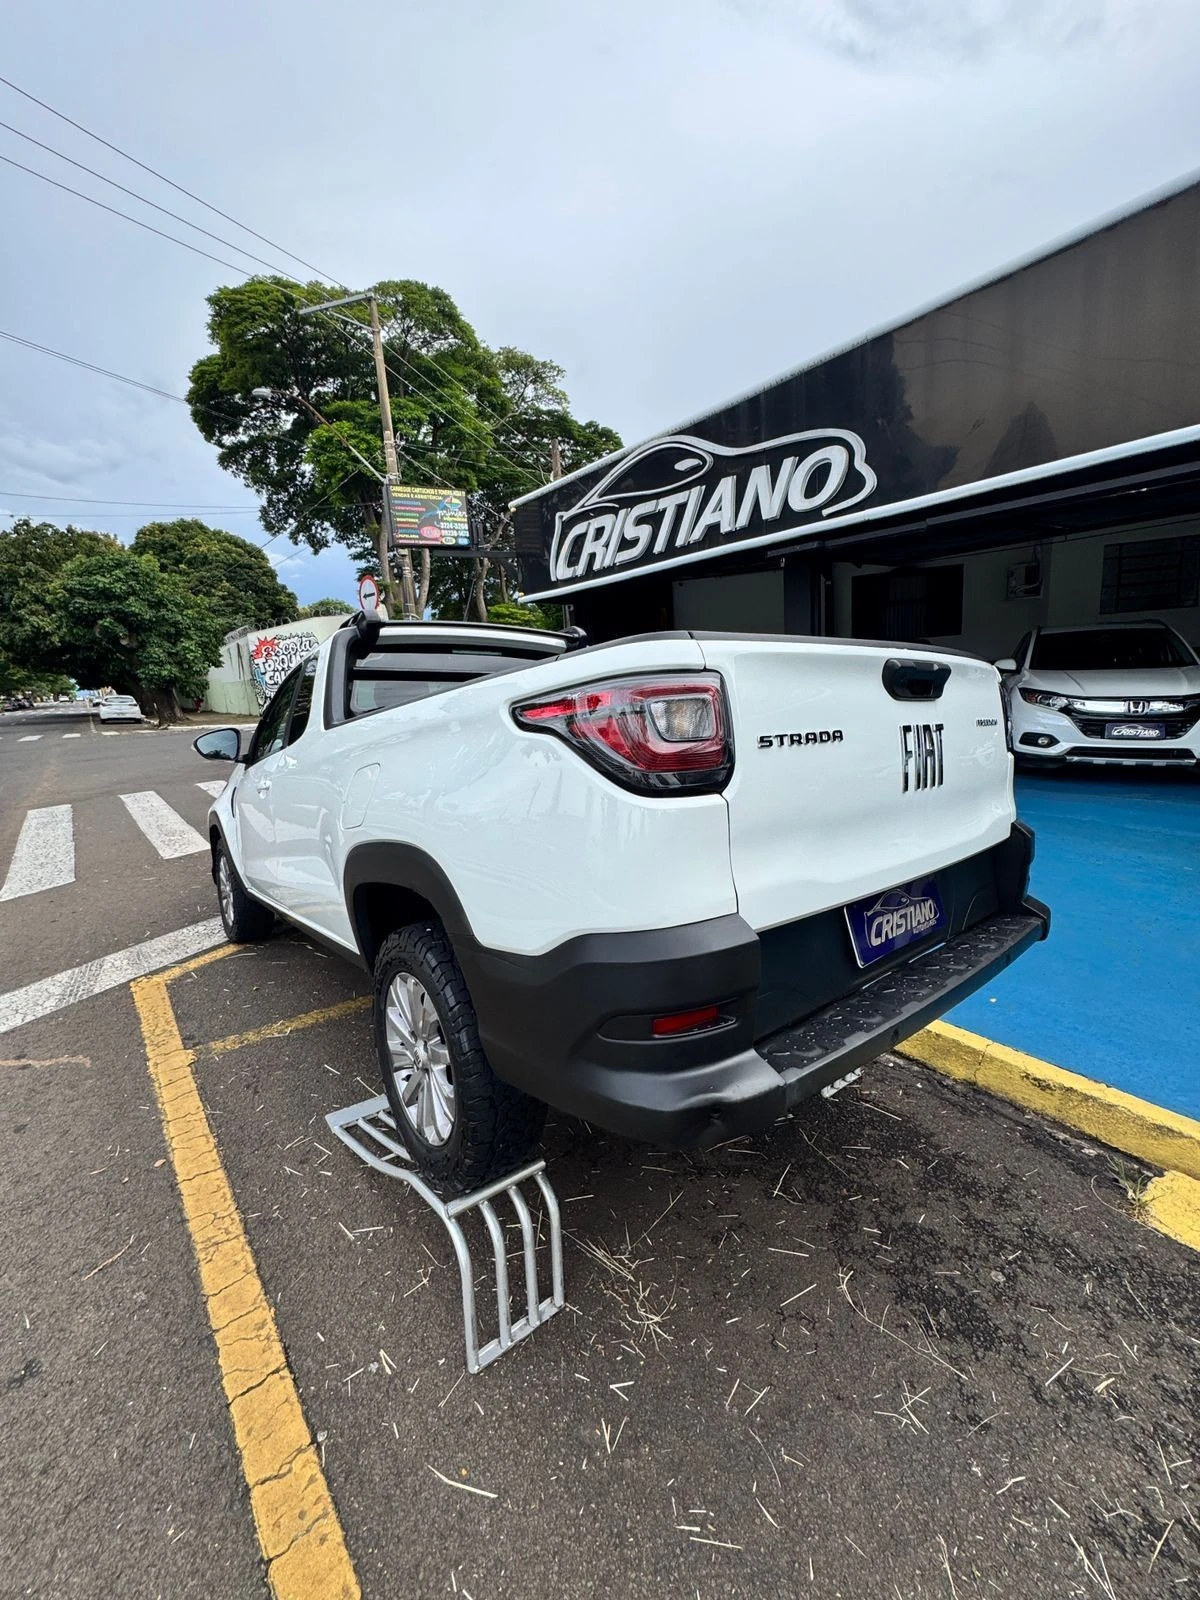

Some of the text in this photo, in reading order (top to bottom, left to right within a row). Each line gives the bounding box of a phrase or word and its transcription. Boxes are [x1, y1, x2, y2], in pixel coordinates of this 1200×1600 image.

[555, 445, 849, 581] CRISTIANO
[261, 637, 313, 660] Escola
[757, 729, 844, 749] STRADA
[1114, 728, 1160, 736] CRISTIANO
[899, 723, 945, 794] FIAT
[870, 900, 935, 947] CRISTIANO
